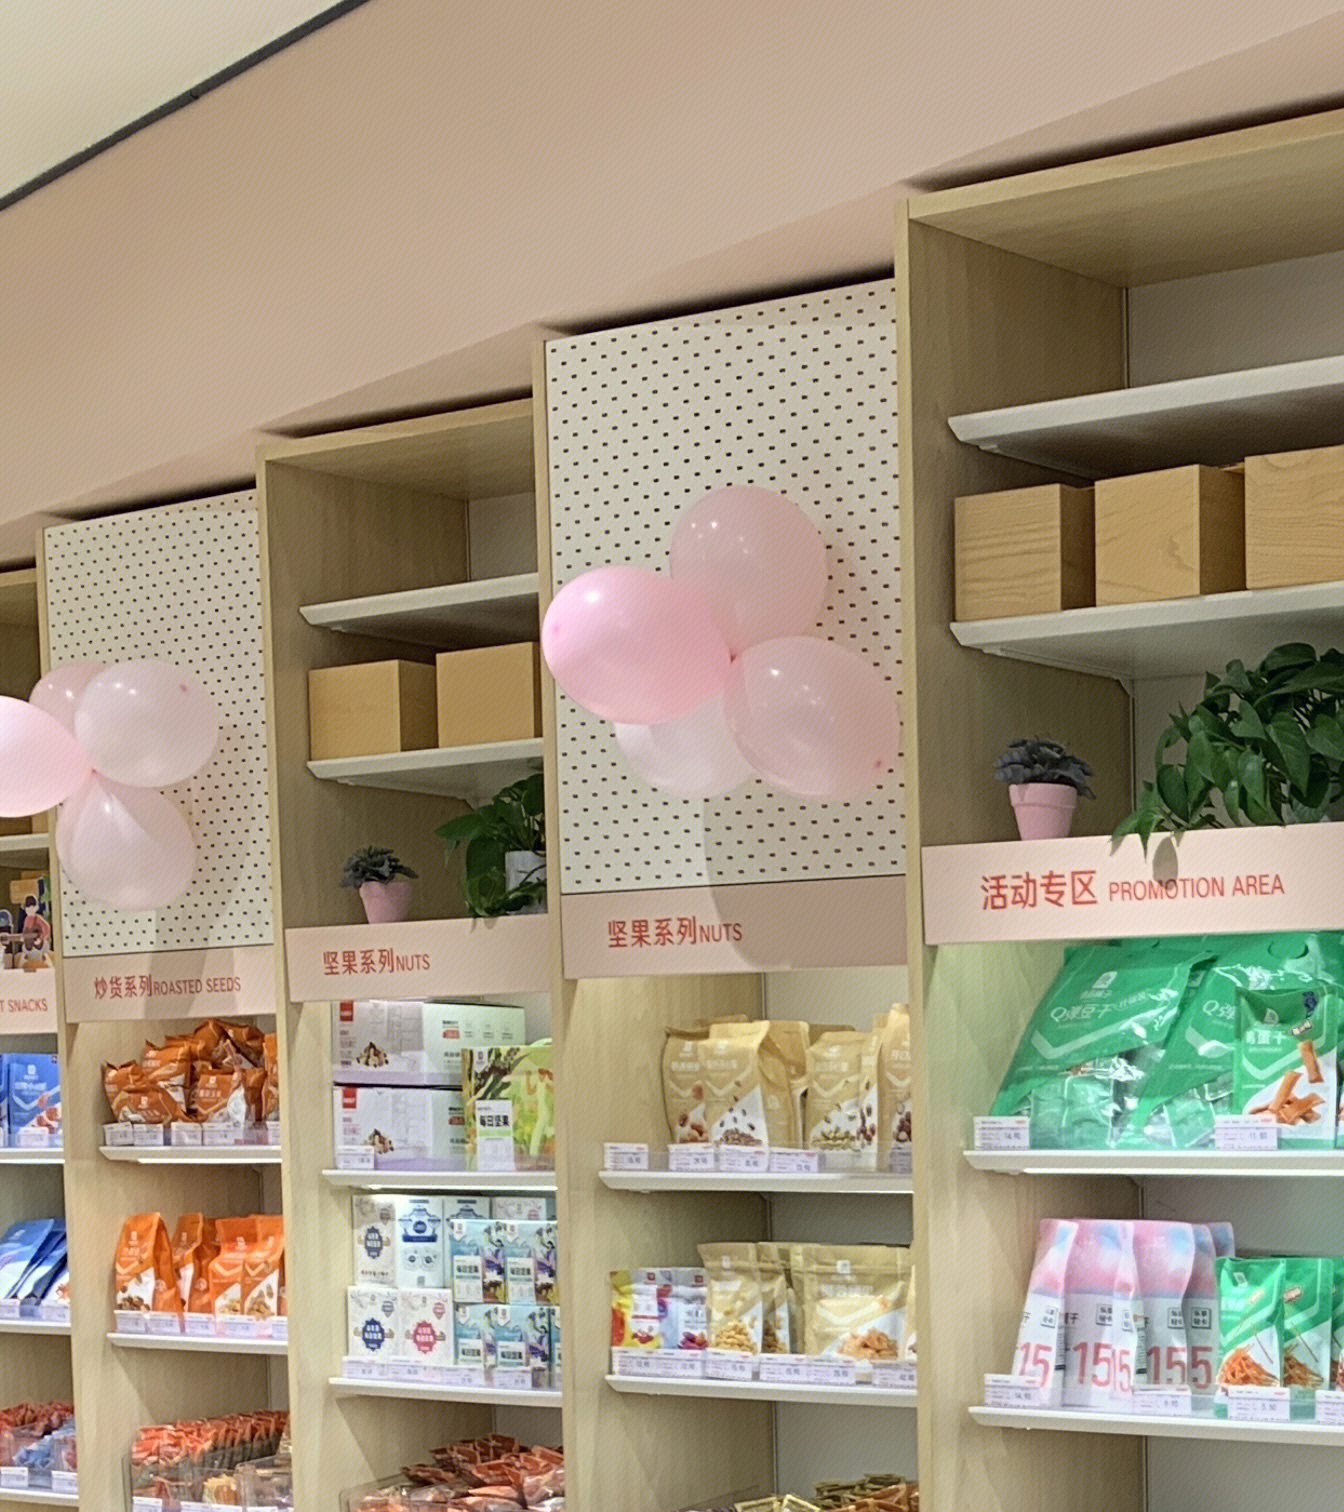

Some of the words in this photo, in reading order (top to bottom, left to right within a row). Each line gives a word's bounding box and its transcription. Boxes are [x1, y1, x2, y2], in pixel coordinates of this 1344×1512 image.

[980, 870, 1098, 911] 活动专区
[1109, 876, 1225, 902] PROMOTION
[1231, 873, 1286, 896] AREA
[607, 915, 697, 949] 坚果系列
[699, 922, 743, 943] NUTS
[322, 947, 395, 977] 坚果系列
[395, 953, 431, 971] NUTS
[94, 974, 153, 999] 炒货系列
[153, 979, 202, 996] ROASTED
[205, 976, 242, 993] SEEDS
[8, 999, 49, 1012] SNACKS
[478, 1114, 511, 1129] 每日坚果
[1072, 1341, 1113, 1387] 15
